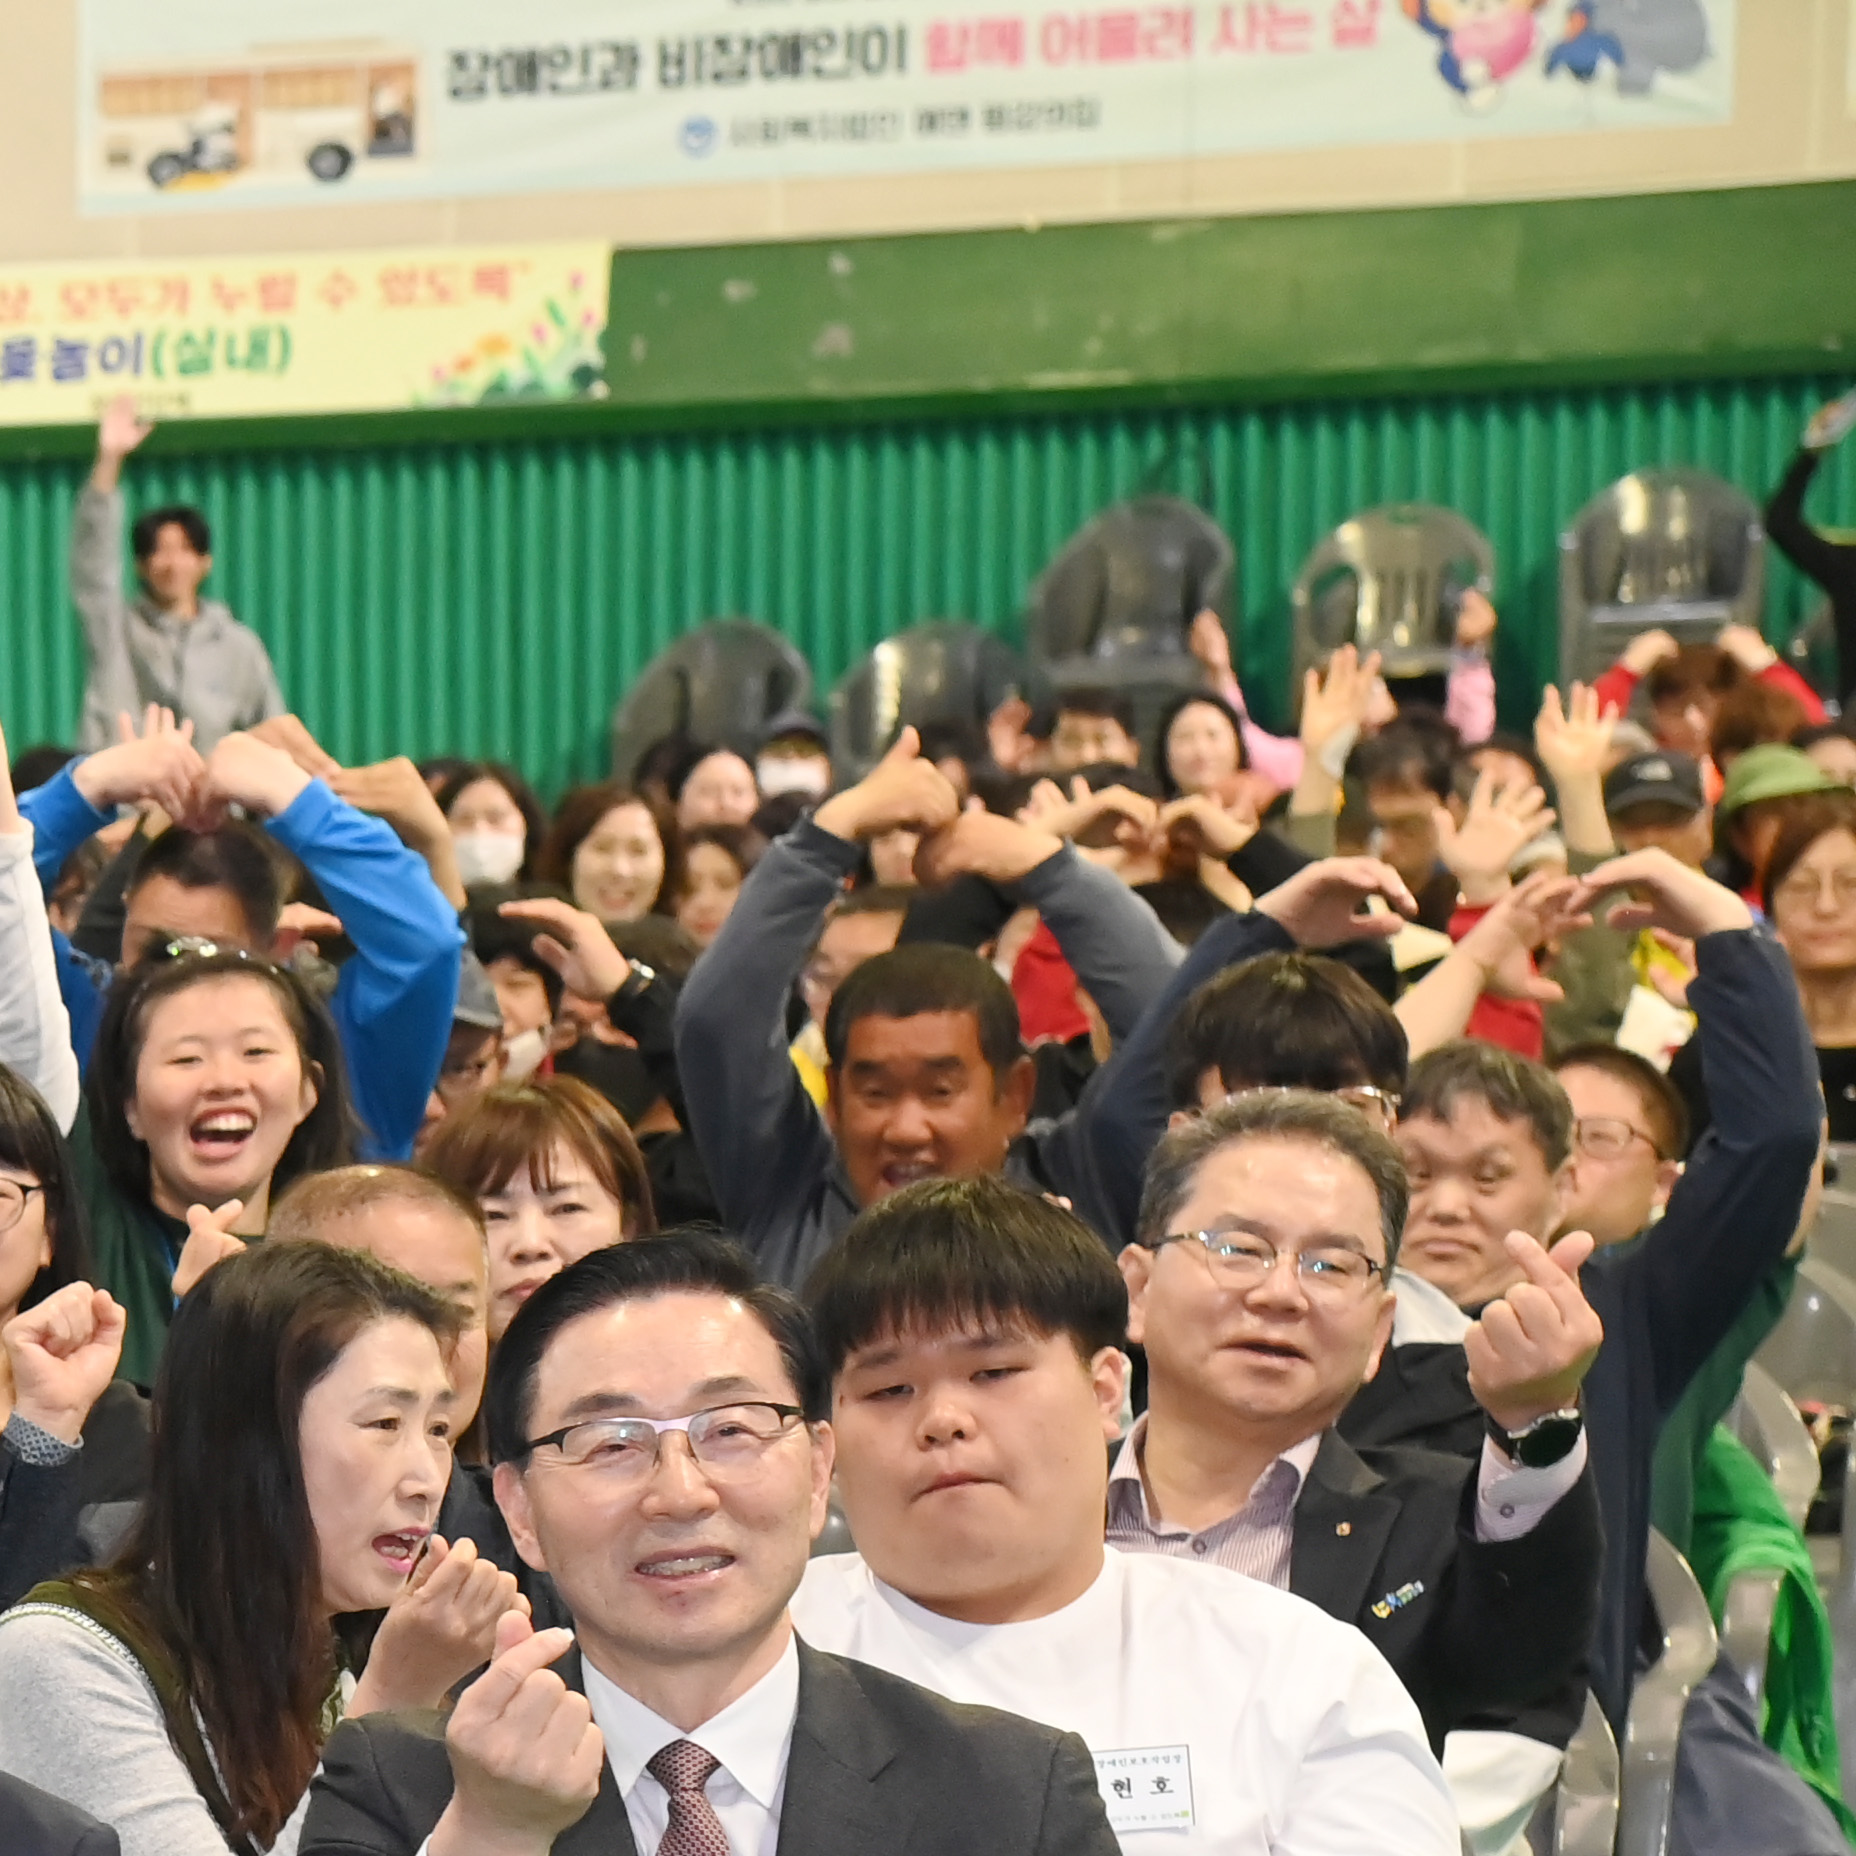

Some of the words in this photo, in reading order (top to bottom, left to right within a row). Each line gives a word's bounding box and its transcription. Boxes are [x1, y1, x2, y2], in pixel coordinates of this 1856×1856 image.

[448, 39, 640, 101] 장애인과
[657, 20, 906, 87] 비장애인이
[925, 17, 1024, 74] 함께
[60, 275, 189, 322] 모두가
[211, 269, 296, 315] 누릴
[317, 267, 356, 310] 수
